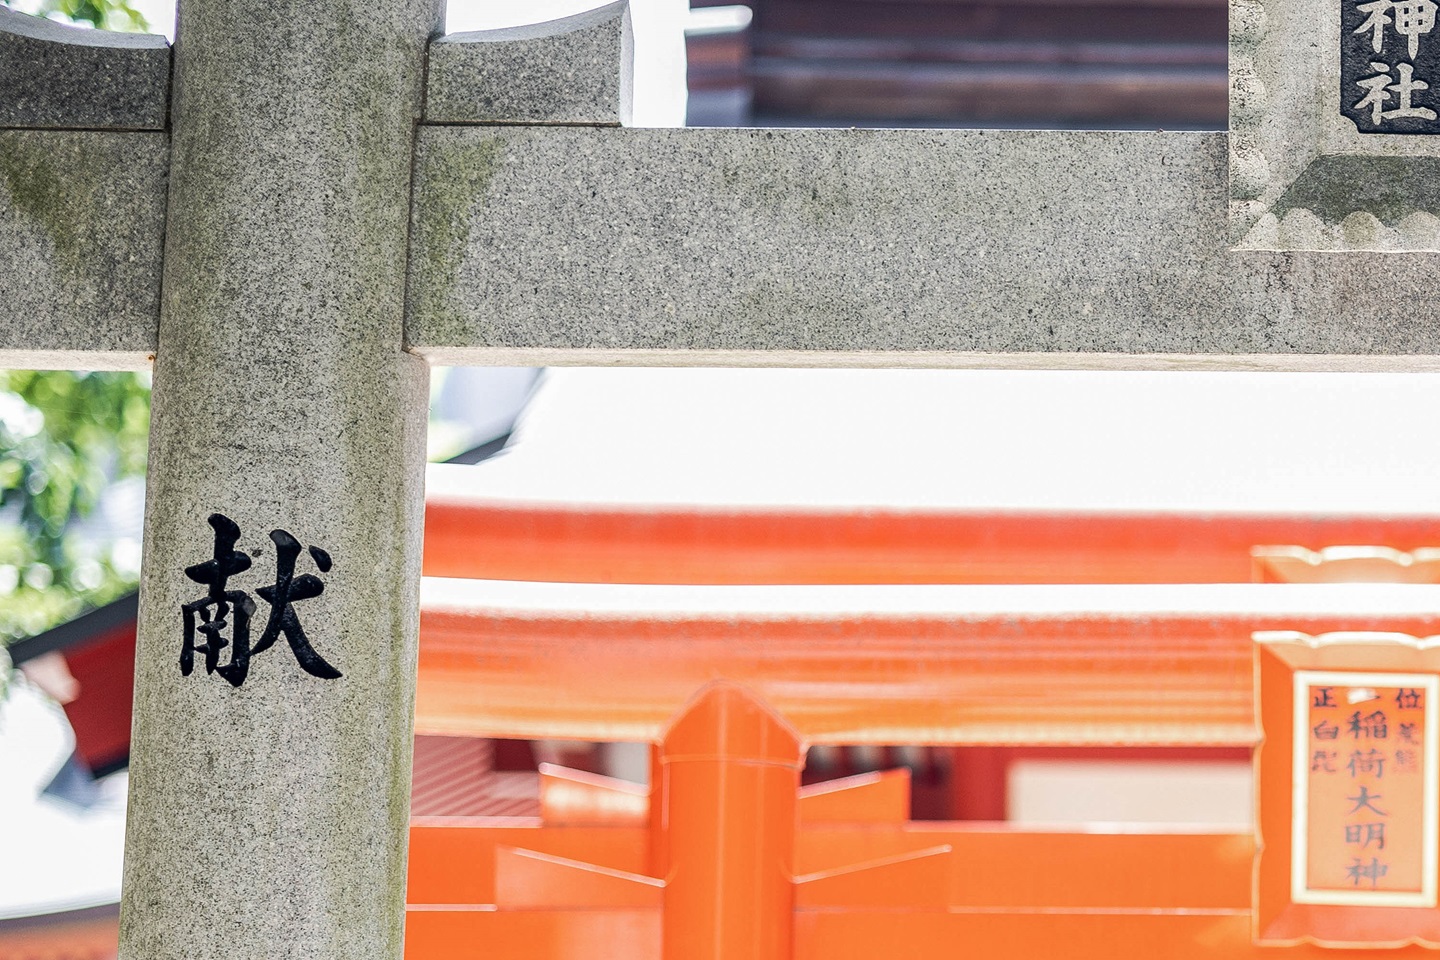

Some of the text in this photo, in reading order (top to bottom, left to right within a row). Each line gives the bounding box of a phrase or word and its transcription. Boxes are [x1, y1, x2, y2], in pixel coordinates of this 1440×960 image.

[1355, 0, 1439, 126] 神社
[179, 513, 343, 687] 献
[1345, 710, 1388, 887] 稲荷大明神
